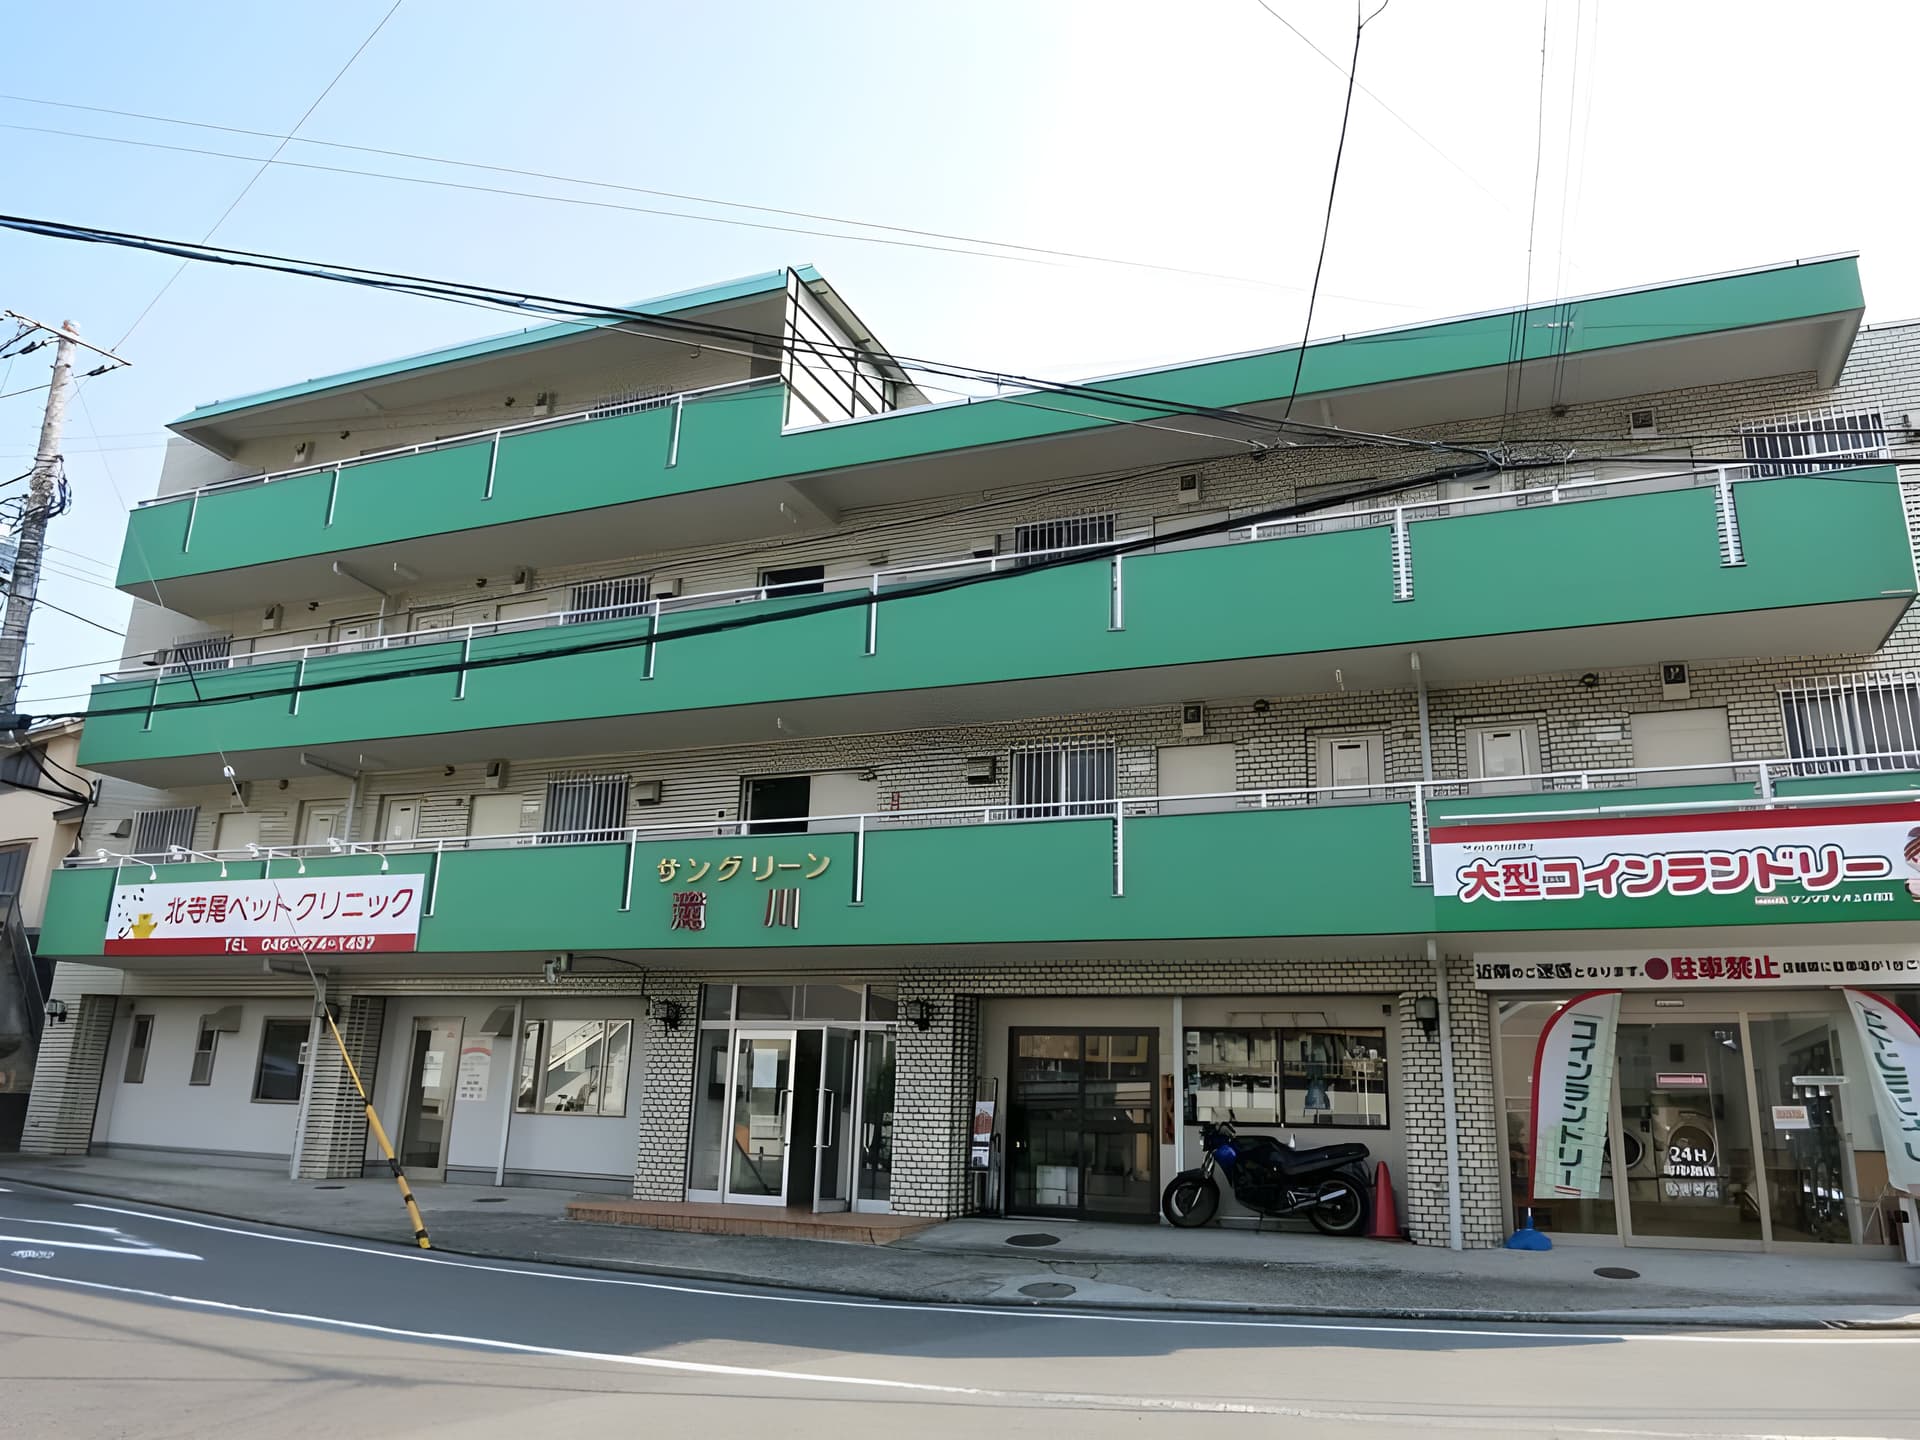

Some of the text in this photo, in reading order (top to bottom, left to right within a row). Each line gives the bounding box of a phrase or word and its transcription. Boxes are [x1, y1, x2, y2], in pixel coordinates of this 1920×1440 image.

[657, 852, 831, 883] サングリーン
[1460, 845, 1891, 902] 大型コインランドリー
[164, 888, 414, 924] 北寺尾ペットクリニック
[225, 937, 248, 952] TEL
[1558, 1019, 1599, 1187] コインランドリー
